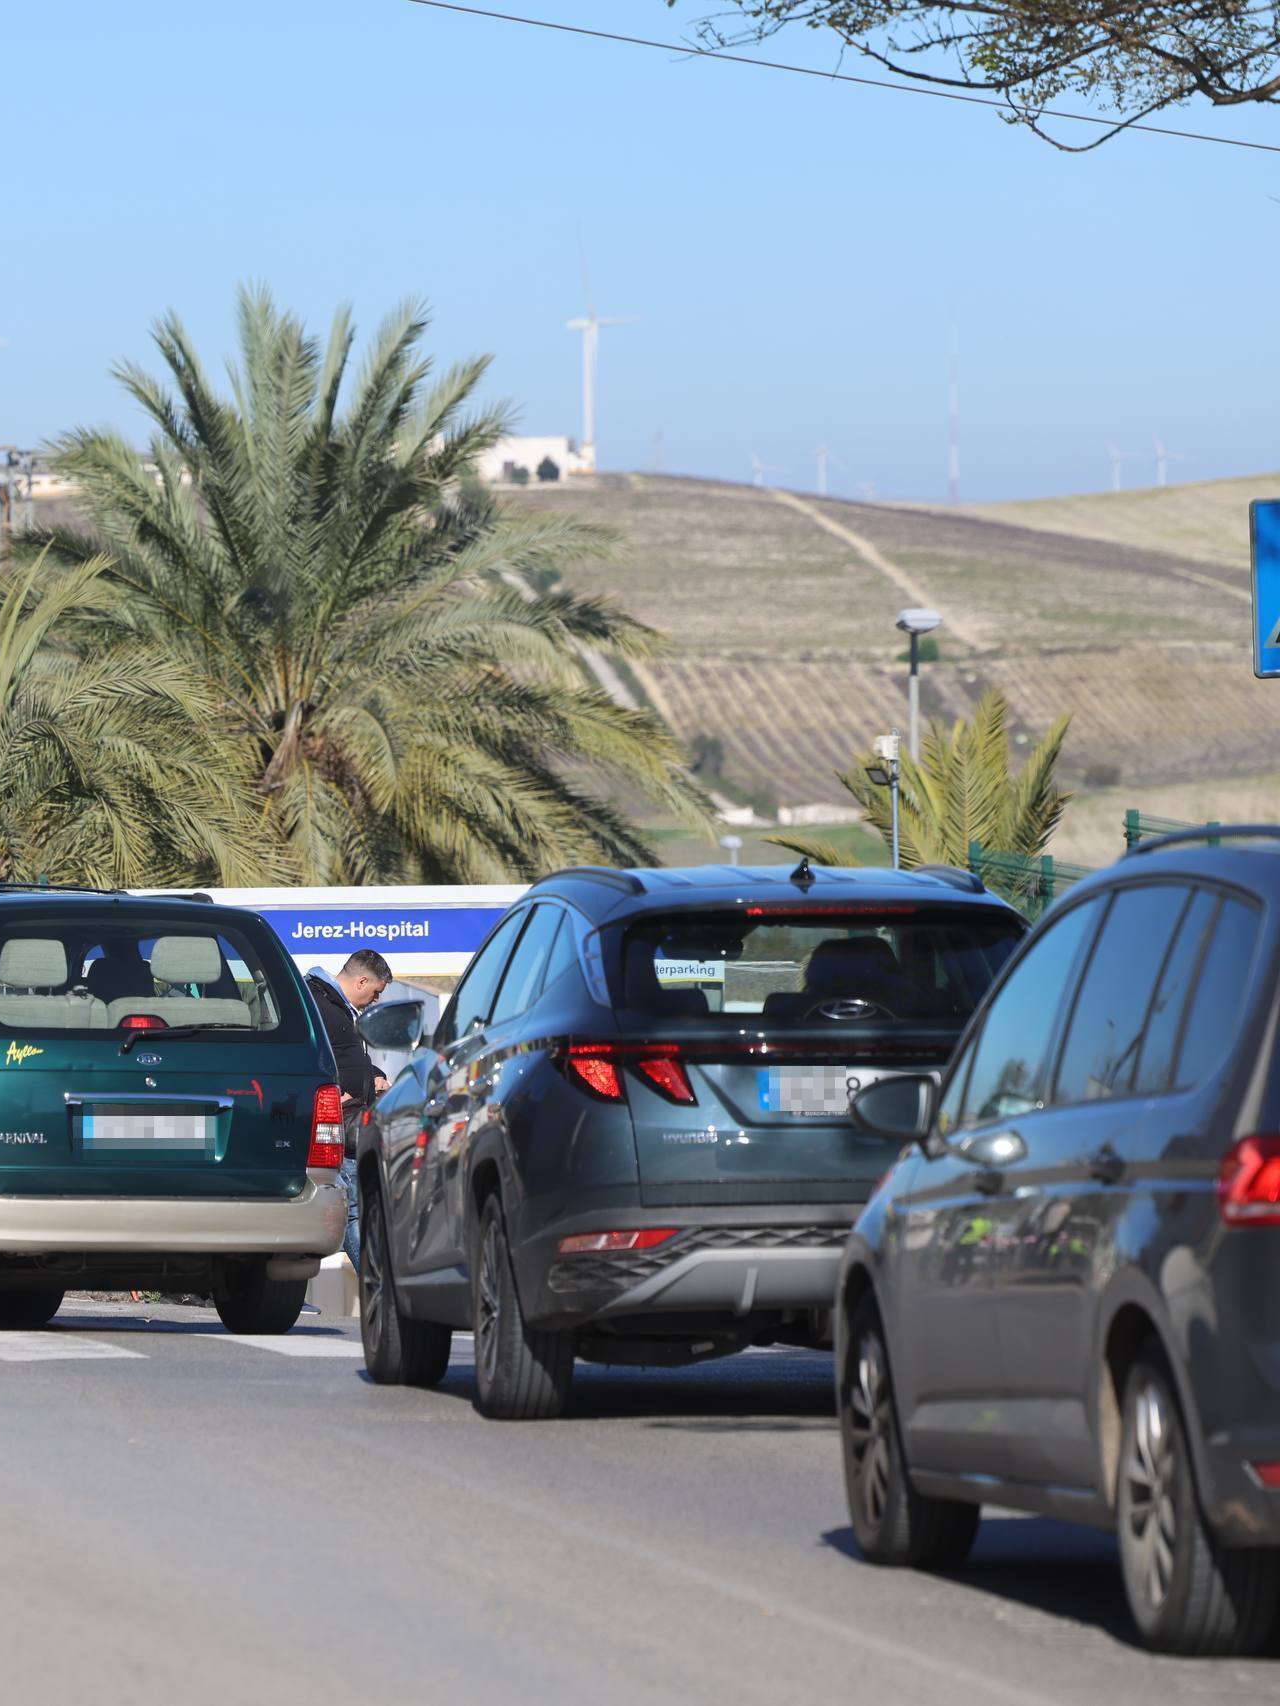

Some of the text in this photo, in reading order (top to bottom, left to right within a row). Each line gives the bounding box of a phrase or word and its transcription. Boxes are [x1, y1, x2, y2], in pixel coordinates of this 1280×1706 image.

[291, 921, 429, 941] Jerez-Hospital
[656, 964, 716, 977] terparking
[275, 1140, 291, 1148] EX
